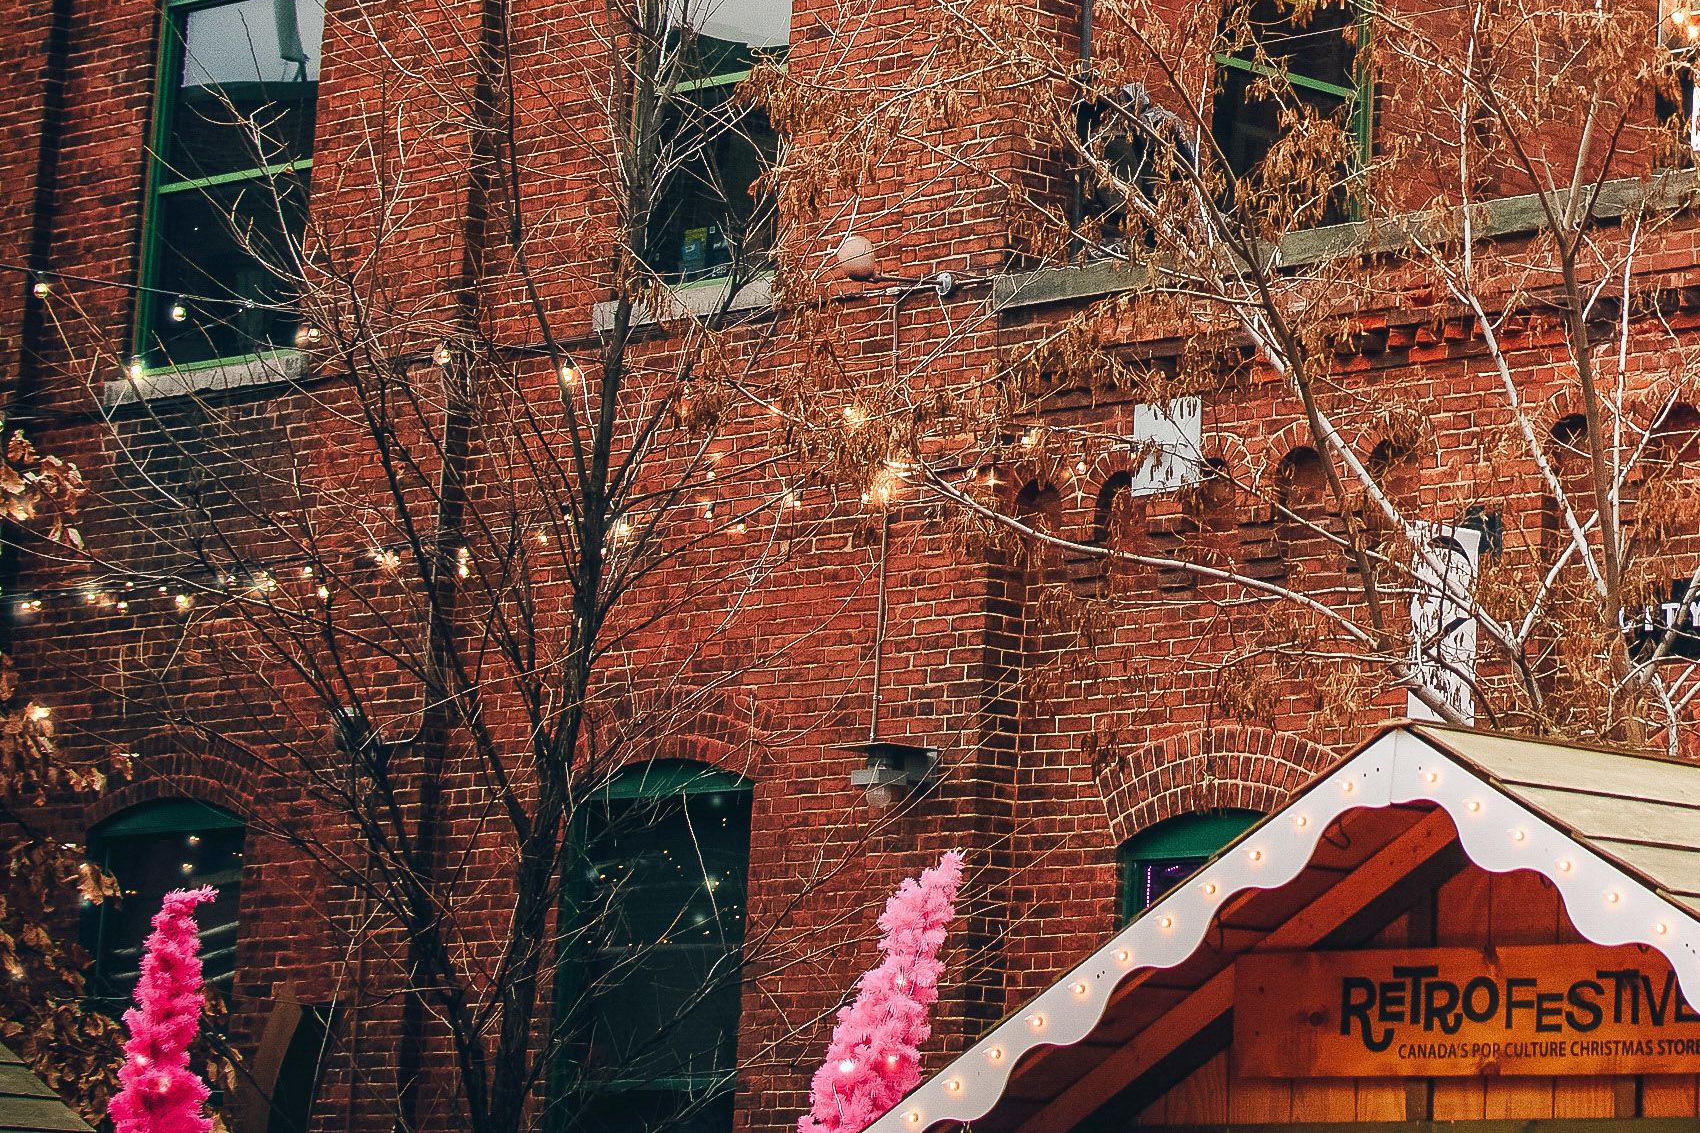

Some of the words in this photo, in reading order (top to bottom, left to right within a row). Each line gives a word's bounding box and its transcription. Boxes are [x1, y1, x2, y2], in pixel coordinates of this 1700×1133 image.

[1397, 1042, 1469, 1059] CANADA'S
[1471, 1042, 1501, 1058] POP
[1503, 1041, 1567, 1058] CULTURE
[1569, 1039, 1654, 1057] CHRISTMAS
